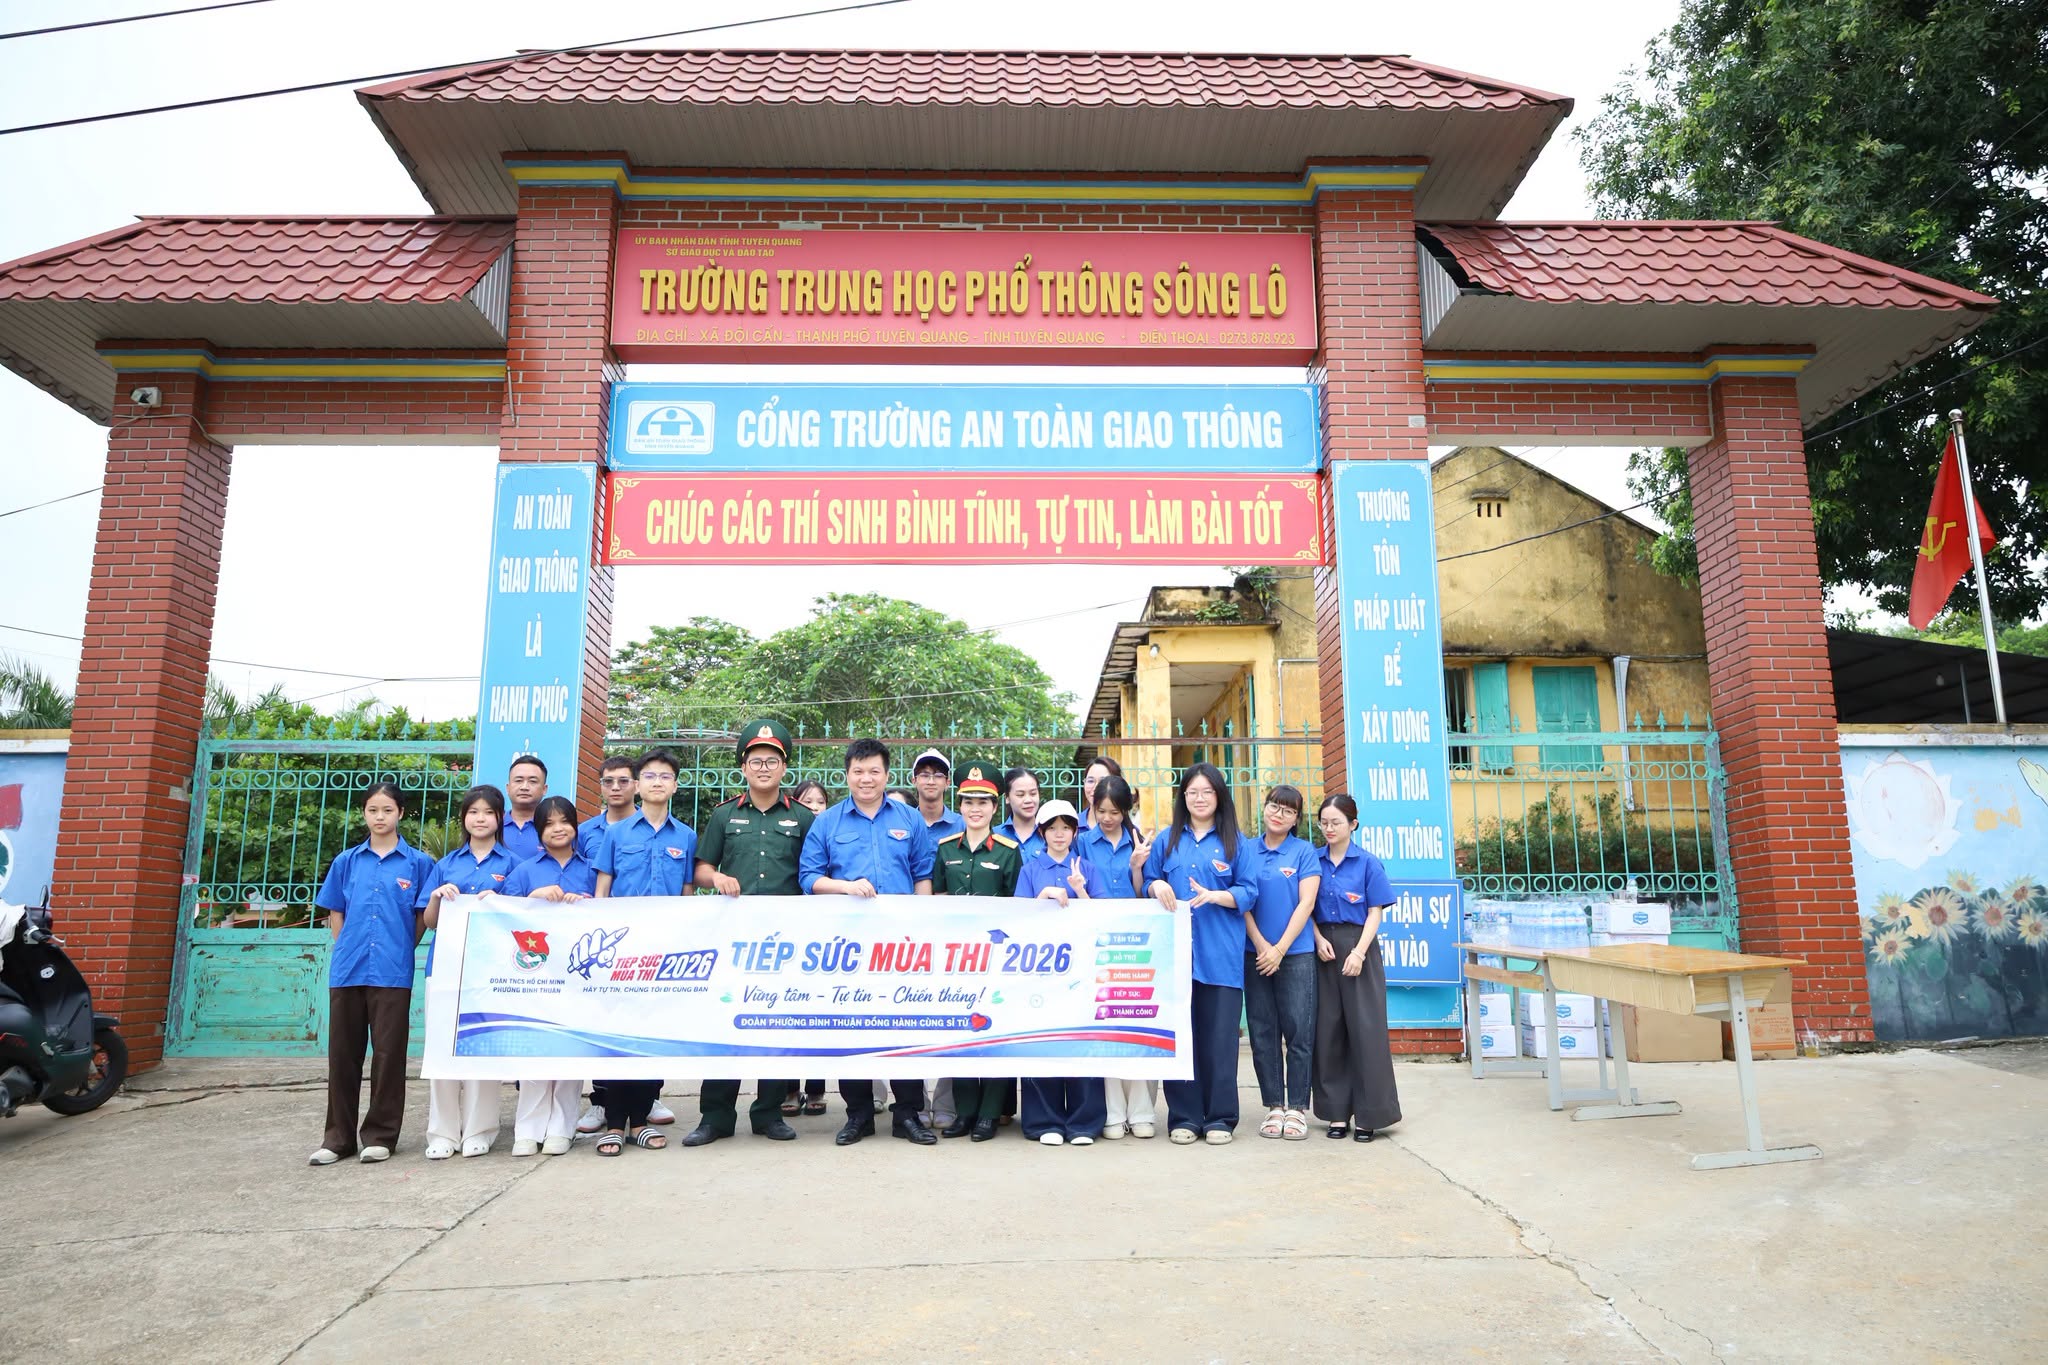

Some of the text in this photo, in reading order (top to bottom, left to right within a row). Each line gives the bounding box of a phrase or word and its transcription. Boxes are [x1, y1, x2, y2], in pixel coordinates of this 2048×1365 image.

[635, 234, 647, 245] ỦY
[649, 237, 668, 245] BAN
[670, 235, 696, 245] NHÂN
[742, 235, 770, 246] TUYÊN
[771, 237, 802, 246] QUANG
[666, 246, 678, 257] SỞ
[680, 246, 701, 257] GIÁO
[703, 248, 721, 258] DỤC
[723, 247, 735, 257] VÀ
[640, 253, 1287, 322] TRƯỜNG TRUNG HỌC PHỔ THÔNG SÔNG LÔ
[636, 329, 660, 343] ĐỊA
[664, 326, 688, 342] CHỈ
[700, 327, 719, 342] XÃ
[724, 326, 749, 343] ĐỘI
[752, 325, 783, 342] CẤN
[796, 328, 839, 343] THÀNH
[843, 326, 871, 343] PHỐ
[876, 327, 915, 343] TUYÊN
[919, 331, 969, 343] QUANG
[983, 327, 1010, 343] TỈNH
[1014, 328, 1053, 343] TUYÊN
[1056, 331, 1105, 344] QUANG
[1139, 328, 1168, 344] ĐIỆN
[1171, 331, 1209, 345] THOẠI
[736, 395, 1282, 449] CỔNG TRƯỜNG AN TOÀN GIAO THÔNG
[513, 487, 573, 530] AN TOÀN
[646, 485, 1283, 554] CHÚC CÁC THÍ SINH BÌNH TĨNH, TỰ TIN, LÀM BÀI TỐT
[1357, 488, 1411, 528] THƯỢNG
[499, 549, 578, 593] GIAO THÔNG
[1373, 538, 1400, 576] TÔN
[525, 613, 542, 657] LÀ
[1354, 592, 1426, 638] PHÁP LUẬT
[1384, 641, 1402, 687] ĐỂ
[489, 678, 569, 731] HẠNH PHÚC
[1361, 704, 1430, 750] XÂY DỰNG
[1369, 761, 1430, 801] VĂN HÓA
[1361, 819, 1443, 860] GIAO THÔNG
[1429, 894, 1452, 929] SỰ
[659, 952, 715, 979] 2026
[731, 932, 1072, 973] TIẾP SỨC MÙA THI 2026
[1399, 934, 1429, 967] VÀO
[610, 967, 657, 981] MÙA THI
[743, 984, 780, 1009] Vững
[784, 987, 811, 1002] tâm
[832, 985, 850, 1005] Tự
[853, 987, 873, 1002] tin
[893, 985, 933, 1003] Chiến
[938, 986, 987, 1010] thắng!
[741, 1015, 969, 1028] ĐOÀN PHƯỜNG BÌNH THUẬN ĐỒNG HÀNH CÙNG SĨ TỬ
